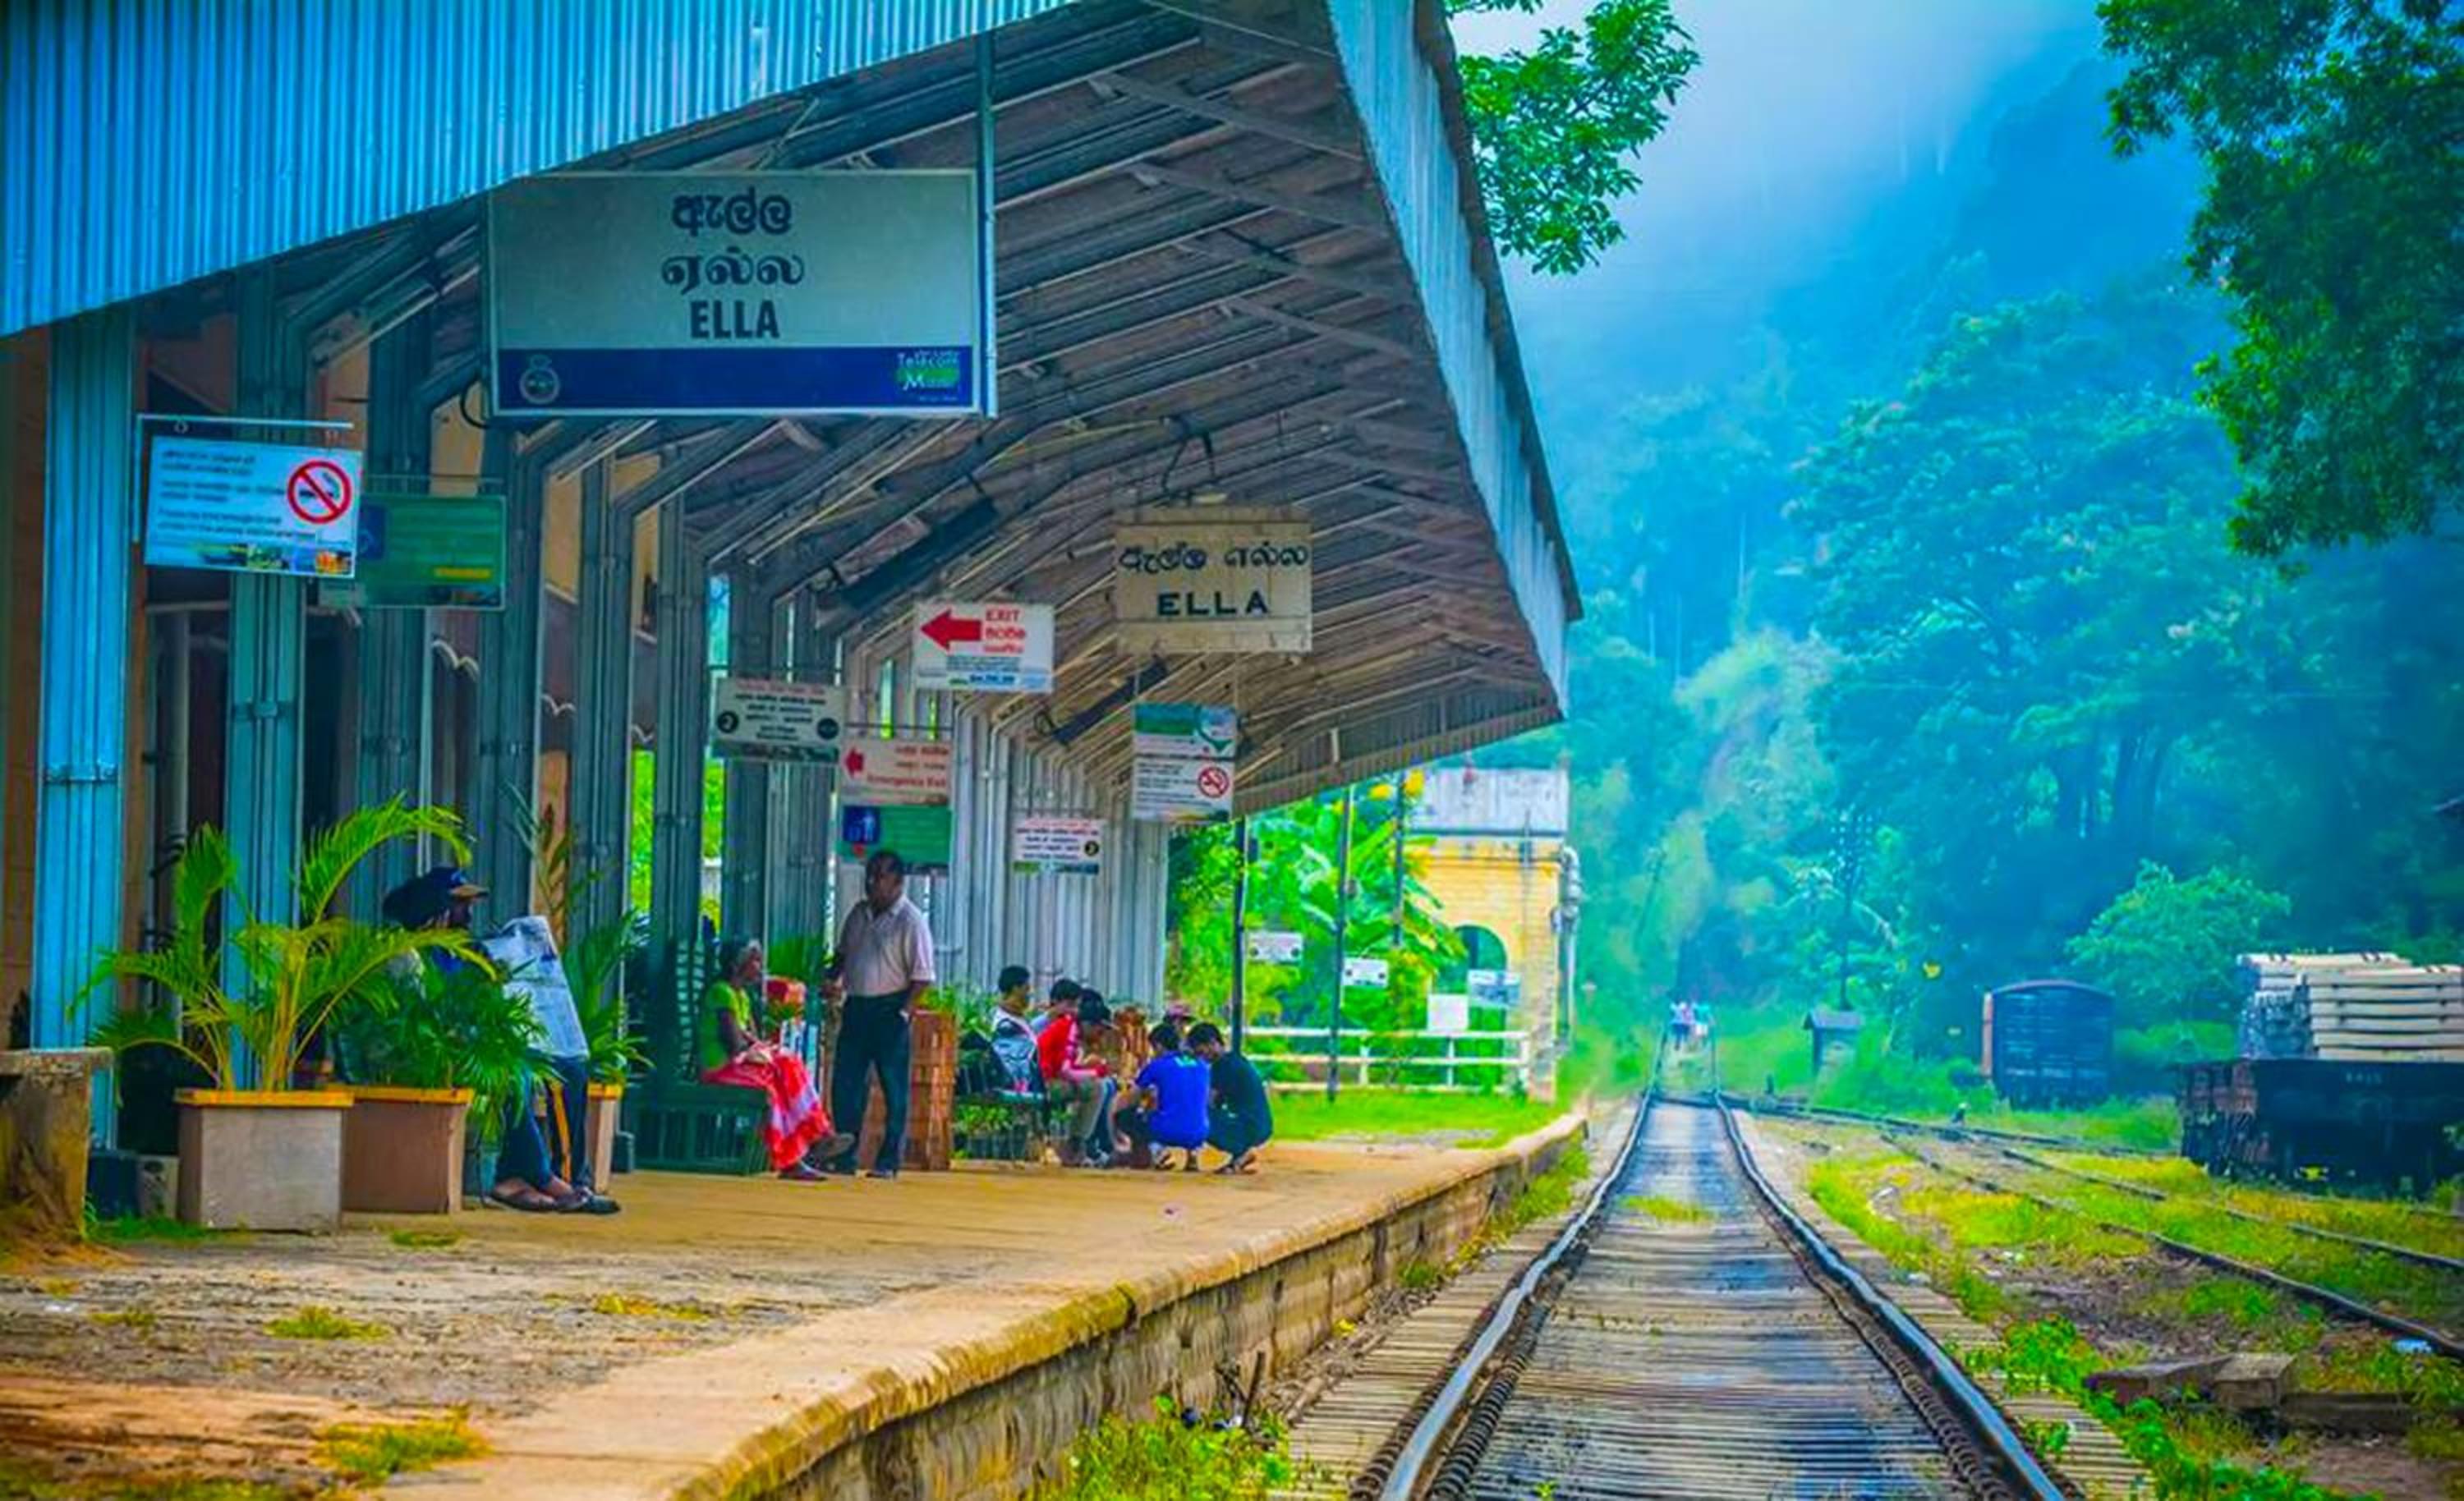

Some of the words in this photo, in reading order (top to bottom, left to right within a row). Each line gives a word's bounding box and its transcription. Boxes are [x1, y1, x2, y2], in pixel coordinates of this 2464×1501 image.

[672, 186, 792, 237] ඇල්ල
[661, 246, 805, 296] ஏல்ல
[690, 300, 780, 339] ELLA
[986, 609, 1020, 622] EXIT
[1157, 591, 1268, 616] ELLA
